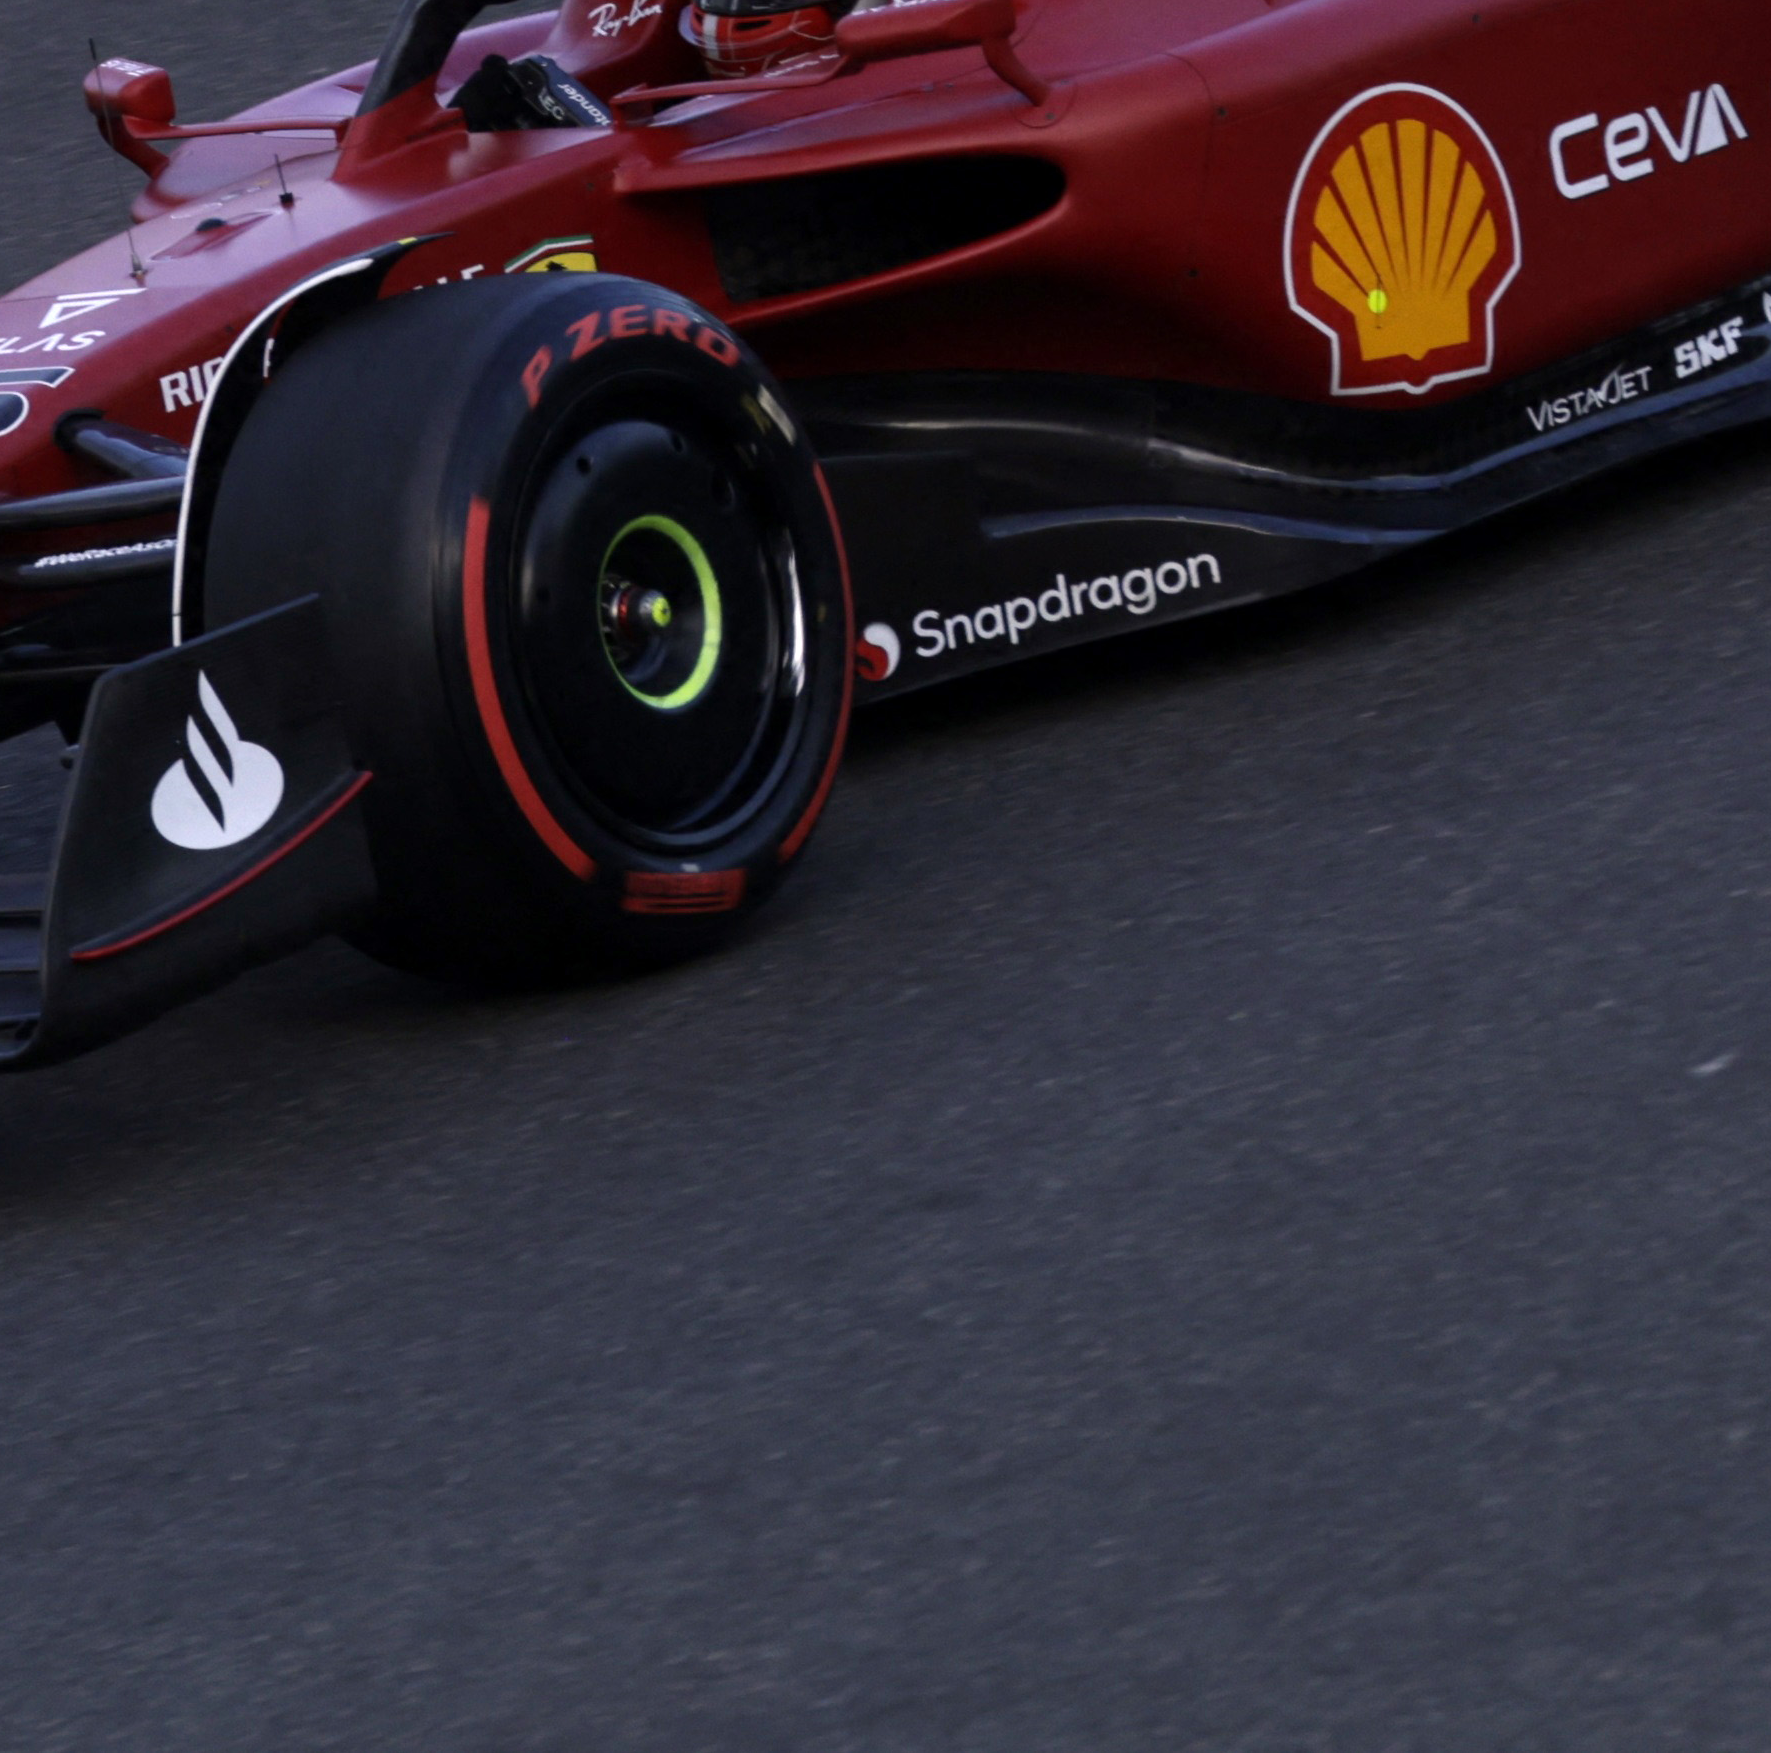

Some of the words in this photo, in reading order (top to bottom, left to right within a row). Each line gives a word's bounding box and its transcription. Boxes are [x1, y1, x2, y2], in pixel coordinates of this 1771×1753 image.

[521, 344, 554, 412] P
[564, 303, 741, 369] ZERO
[1674, 316, 1744, 379] SKF
[912, 553, 1222, 658] Snapdragon
